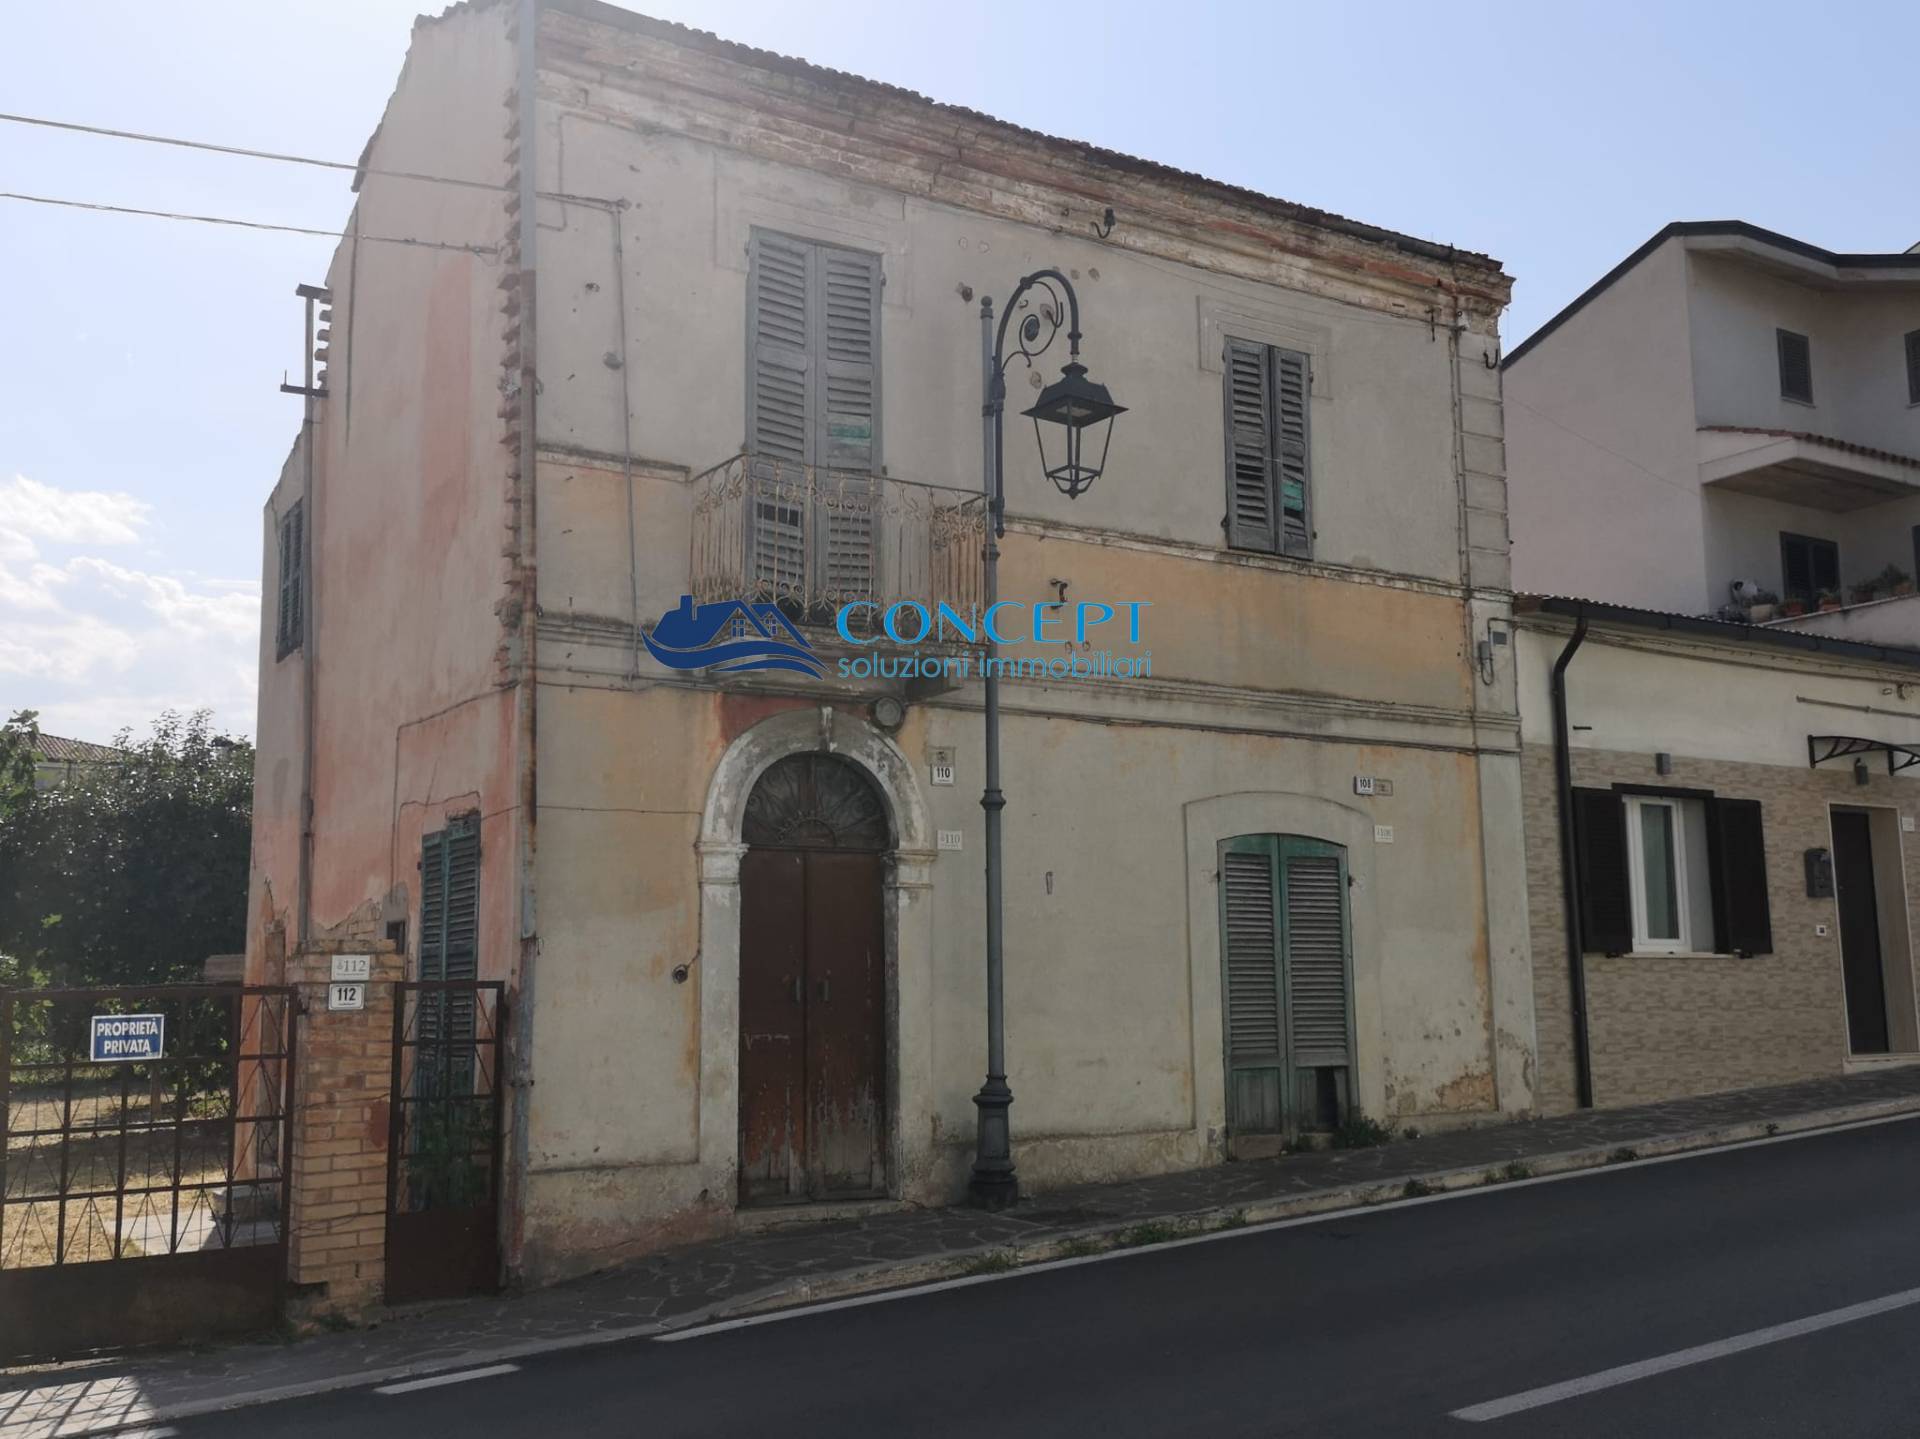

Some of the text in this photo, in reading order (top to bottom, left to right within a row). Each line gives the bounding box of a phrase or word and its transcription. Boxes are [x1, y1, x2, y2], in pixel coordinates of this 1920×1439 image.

[937, 767, 951, 778] 110
[337, 987, 356, 1001] 112
[97, 1017, 158, 1036] PROPRIETÀ
[104, 1038, 150, 1054] PRIVATA
